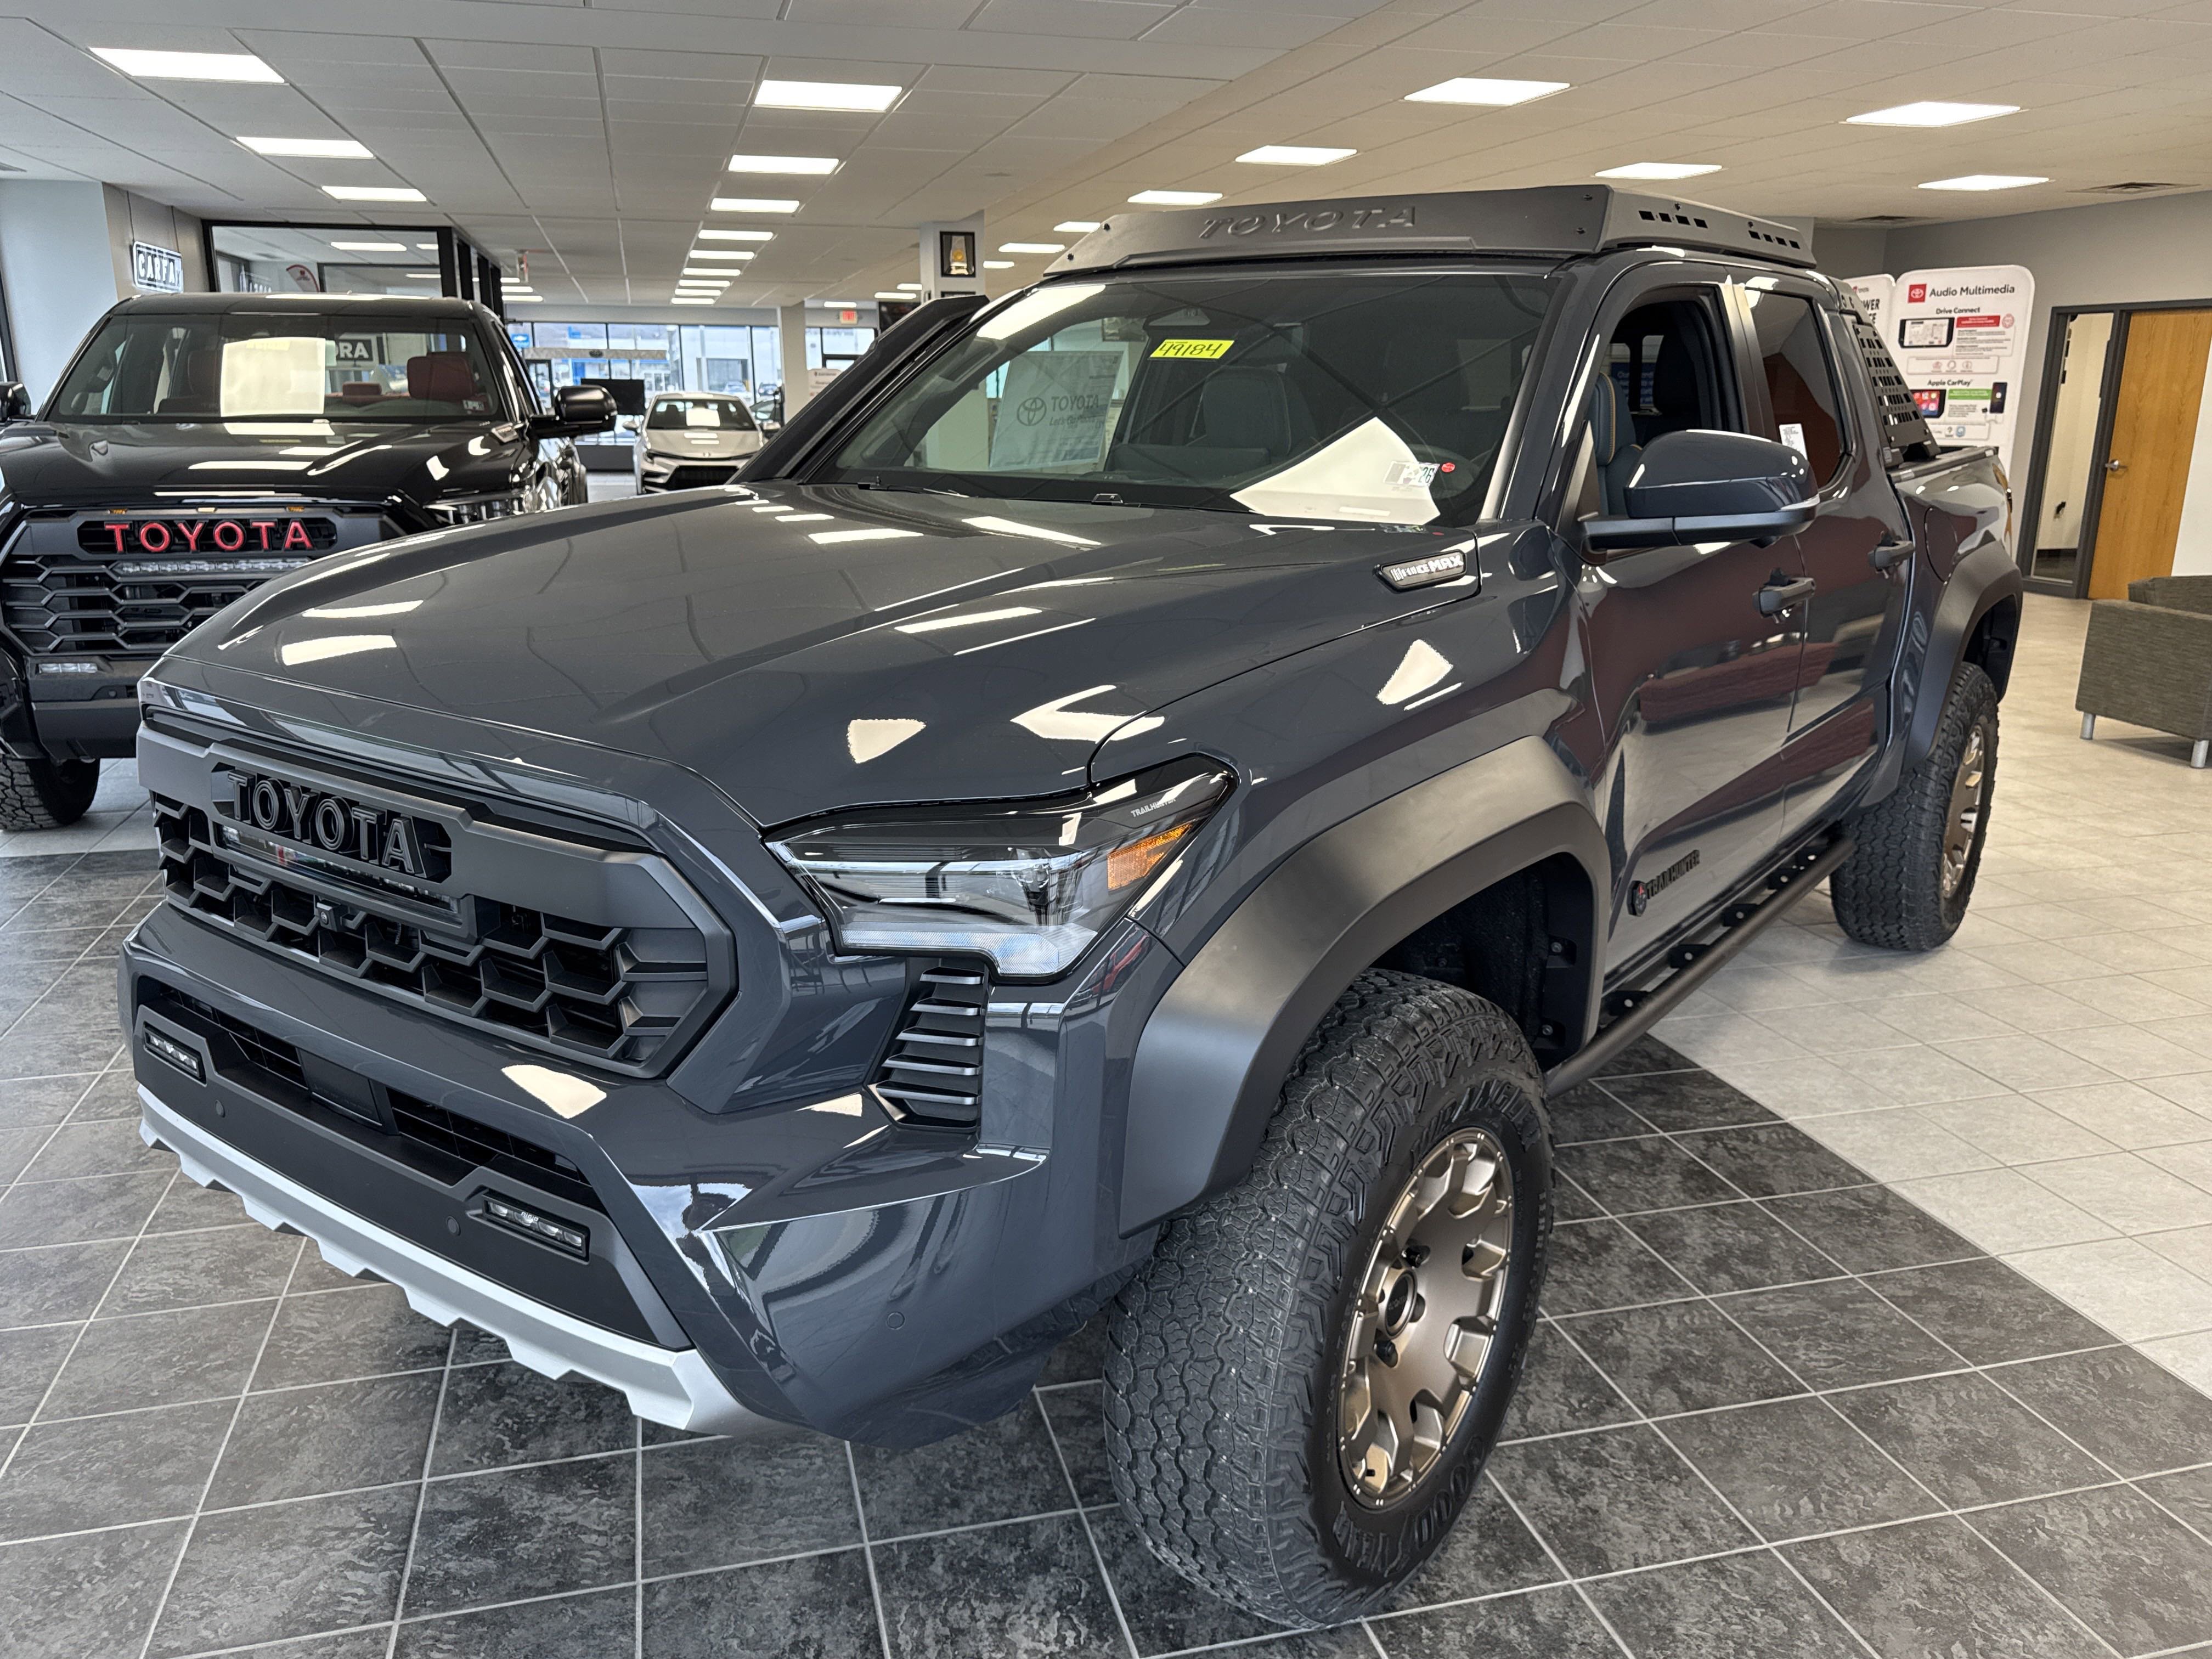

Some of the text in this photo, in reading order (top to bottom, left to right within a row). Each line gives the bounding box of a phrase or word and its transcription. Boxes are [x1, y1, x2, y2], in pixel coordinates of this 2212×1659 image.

[1199, 206, 1416, 239] TOYOTA
[138, 253, 182, 285] CARFAX
[1929, 284, 2015, 297] Audio Multimedia
[335, 342, 369, 359] RA
[1159, 343, 1223, 357] 49184
[1947, 379, 1971, 387] CarPlay
[1051, 395, 1099, 412] TOYOTA
[105, 520, 313, 554] TOYOTA
[1427, 555, 1464, 573] MAX
[226, 769, 421, 876] TOYOTA
